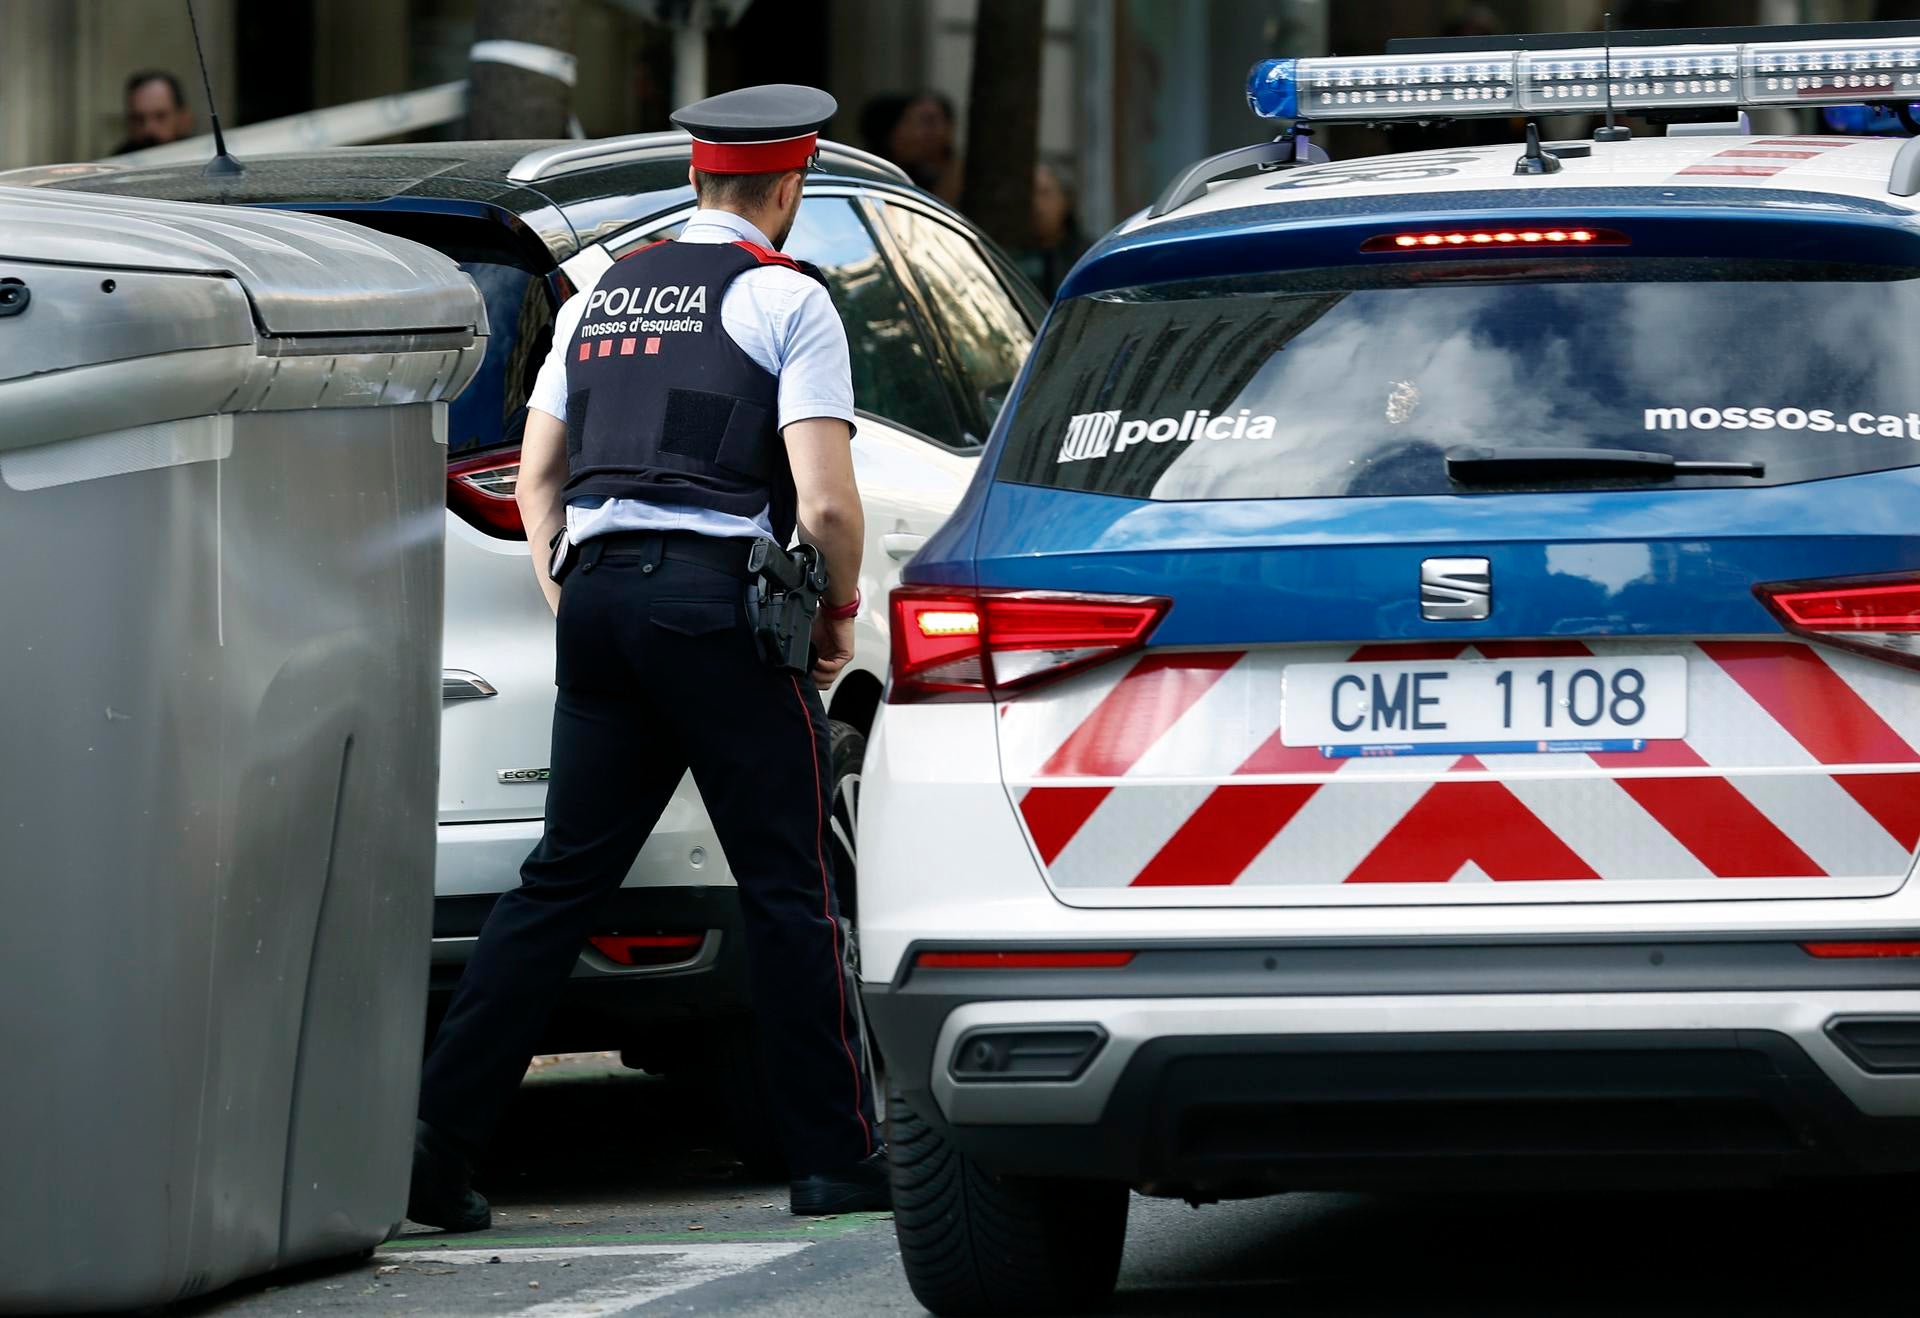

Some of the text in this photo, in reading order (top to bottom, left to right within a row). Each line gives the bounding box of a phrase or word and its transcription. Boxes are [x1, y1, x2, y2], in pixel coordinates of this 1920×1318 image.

[585, 286, 706, 319] POLICIA
[581, 316, 703, 338] mossos d'esquadra
[1113, 409, 1278, 452] policia
[1644, 407, 1920, 440] mossos.cat
[1331, 668, 1646, 732] CME 1108
